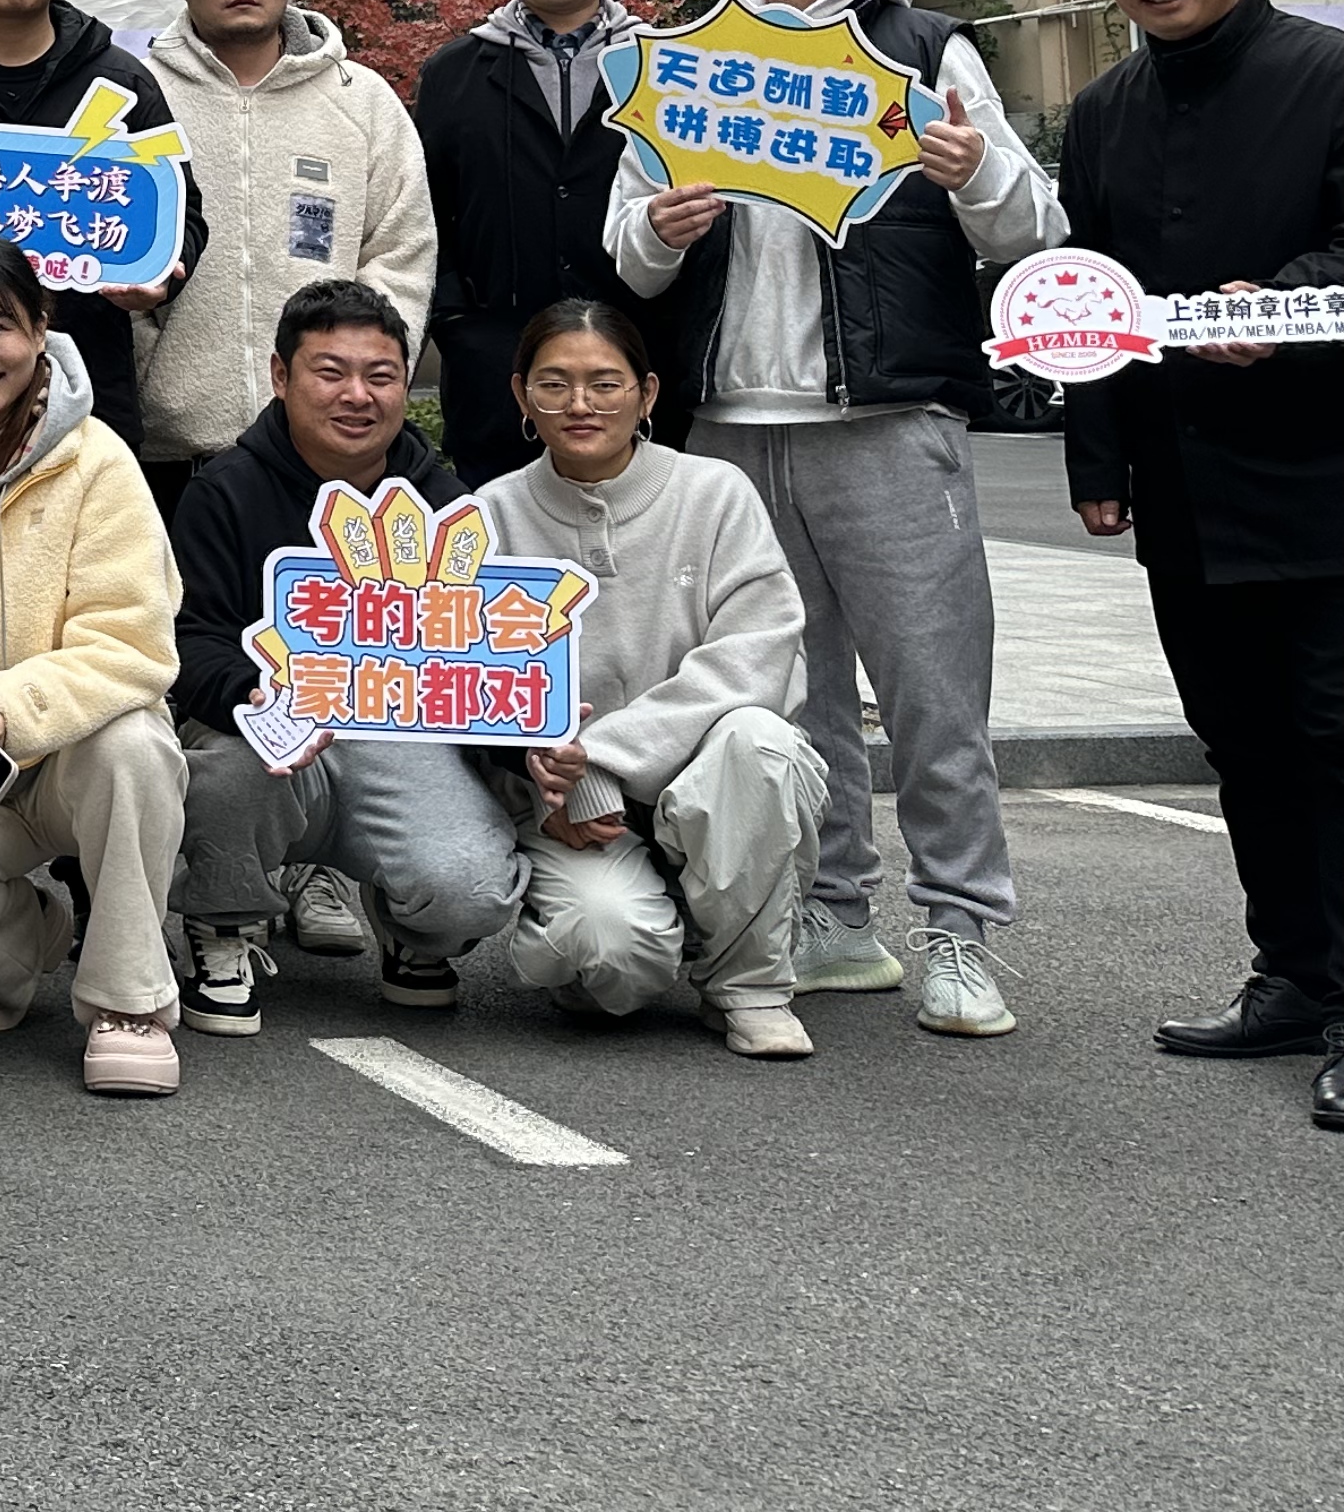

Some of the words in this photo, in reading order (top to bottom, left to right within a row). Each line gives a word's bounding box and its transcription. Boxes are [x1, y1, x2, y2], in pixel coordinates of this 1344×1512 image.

[656, 47, 869, 120] 天道酬勤
[663, 103, 875, 179] 拼搏进取
[1027, 332, 1119, 354] HZMBA
[343, 516, 379, 568] 必过
[392, 513, 420, 565] 必过
[445, 528, 479, 580] 必过
[287, 577, 551, 655] 考的都会
[288, 653, 550, 731] 蒙的都对
